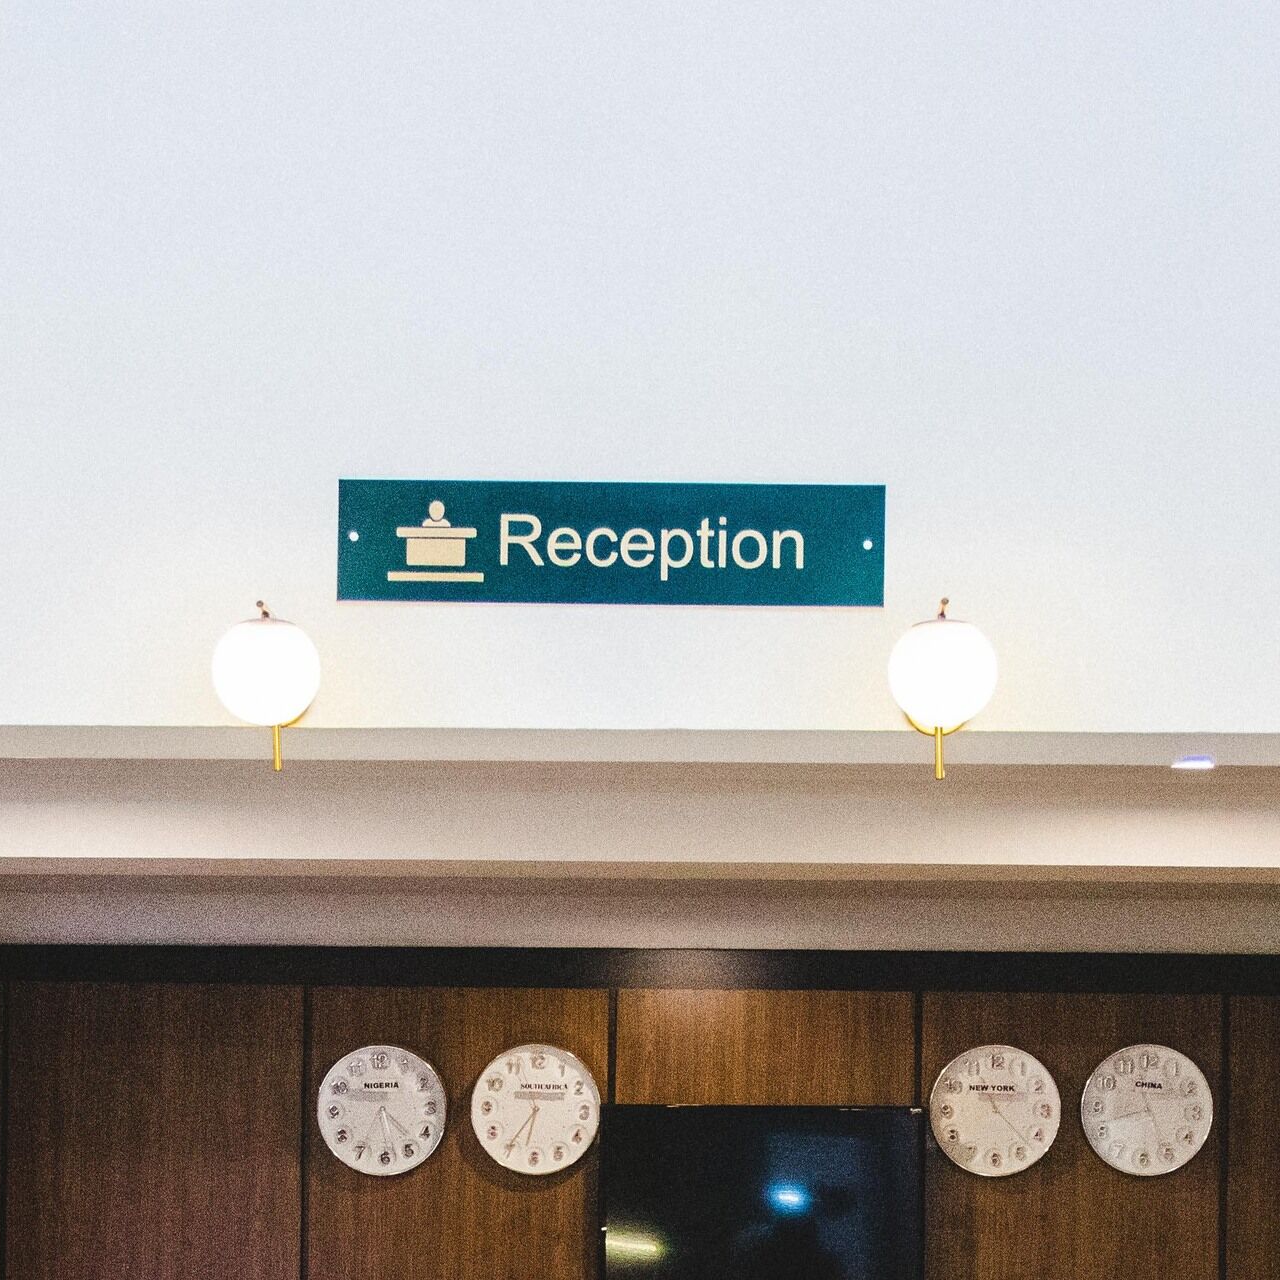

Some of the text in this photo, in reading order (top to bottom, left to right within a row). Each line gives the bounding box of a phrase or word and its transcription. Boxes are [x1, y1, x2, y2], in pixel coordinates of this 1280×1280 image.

[500, 513, 804, 581] Reception
[371, 1053, 388, 1069] 12
[506, 1058, 520, 1075] 11
[530, 1055, 545, 1070] 12
[965, 1060, 980, 1076] 11
[989, 1055, 1004, 1070] 12
[1119, 1060, 1134, 1074] 11
[1142, 1055, 1159, 1070] 12
[332, 1080, 348, 1095] 10
[487, 1077, 503, 1091] 10
[574, 1080, 584, 1095] 2
[1034, 1079, 1044, 1093] 2
[1098, 1076, 1116, 1091] 10
[1135, 1081, 1162, 1090] CHINA
[1187, 1081, 1197, 1095] 2
[329, 1105, 340, 1119] 9
[425, 1101, 436, 1115] 3
[481, 1101, 492, 1116] 9
[579, 1104, 590, 1120] 3
[942, 1104, 952, 1119] 9
[1040, 1103, 1051, 1119] 3
[1093, 1100, 1103, 1114] 9
[1192, 1104, 1202, 1120] 3
[337, 1128, 348, 1143] 8
[419, 1125, 431, 1140] 4
[487, 1125, 498, 1140] 8
[572, 1128, 582, 1144] 4
[949, 1128, 959, 1142] 8
[1033, 1128, 1043, 1142] 4
[1098, 1125, 1108, 1139] 8
[1184, 1130, 1194, 1145] 4
[355, 1144, 366, 1160] 7
[380, 1151, 391, 1165] 6
[404, 1143, 414, 1158] 5
[553, 1145, 564, 1161] 5
[1016, 1146, 1026, 1160] 5
[1114, 1144, 1124, 1159] 7
[1164, 1147, 1174, 1161] 5
[528, 1151, 539, 1167] 6
[991, 1152, 1001, 1167] 6
[1139, 1152, 1149, 1167] 6
